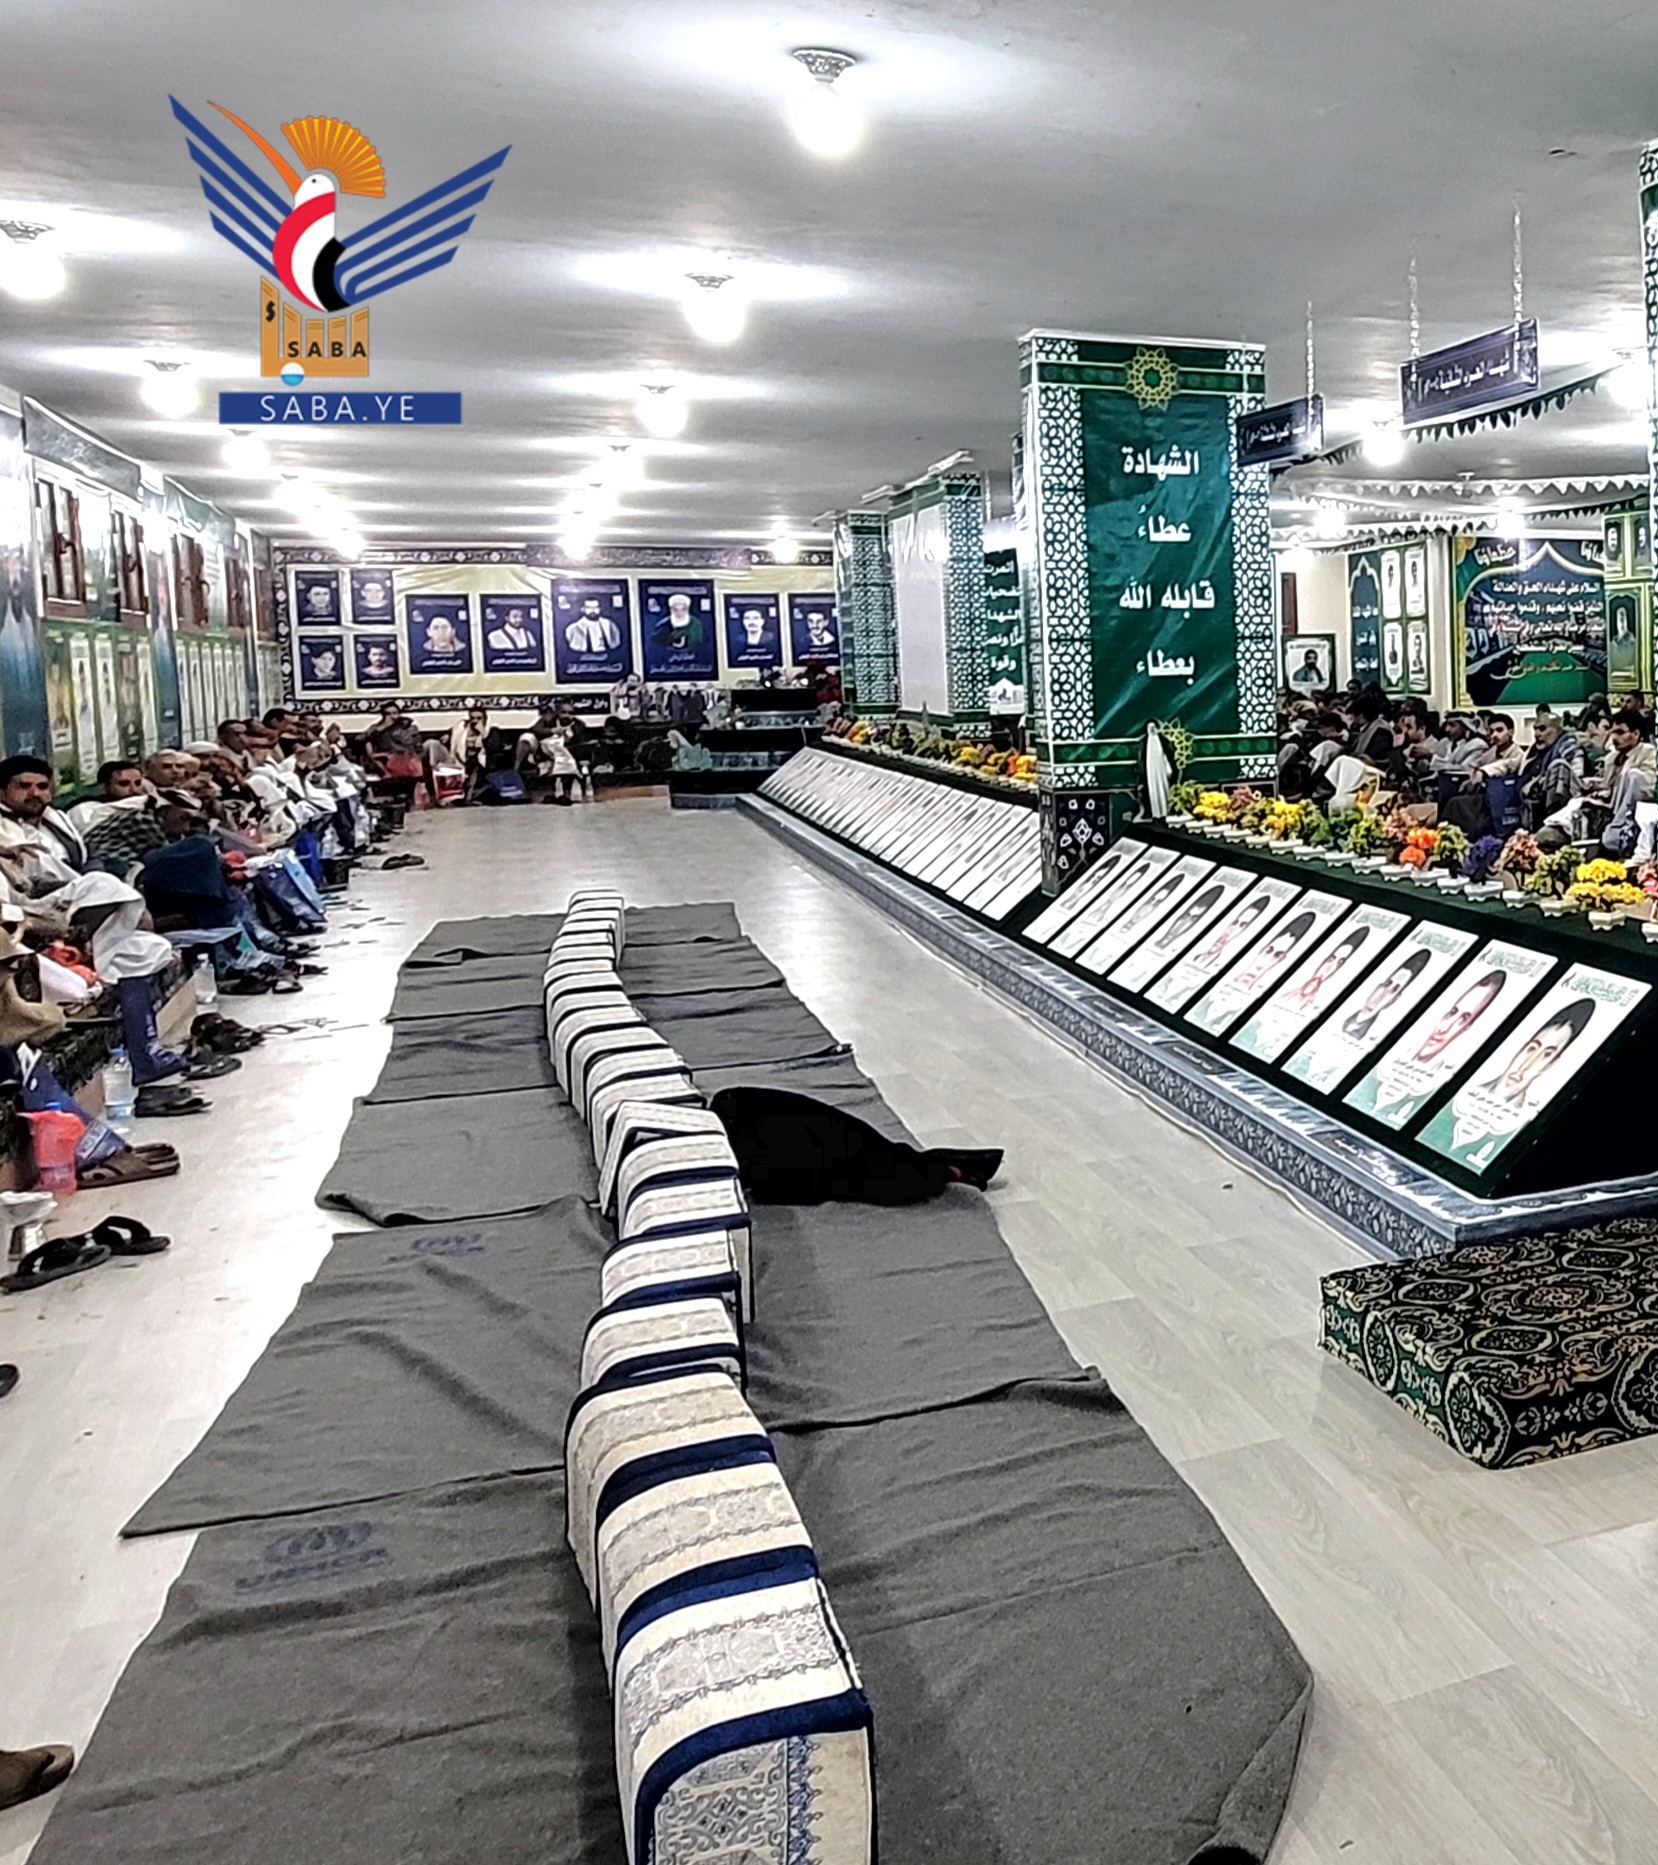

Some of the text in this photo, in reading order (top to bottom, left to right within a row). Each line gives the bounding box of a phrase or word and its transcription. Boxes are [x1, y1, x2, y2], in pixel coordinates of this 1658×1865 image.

[1121, 444, 1200, 482] الشهادة
[1119, 576, 1215, 619] قابله الله
[1135, 648, 1195, 685] بعطاء
